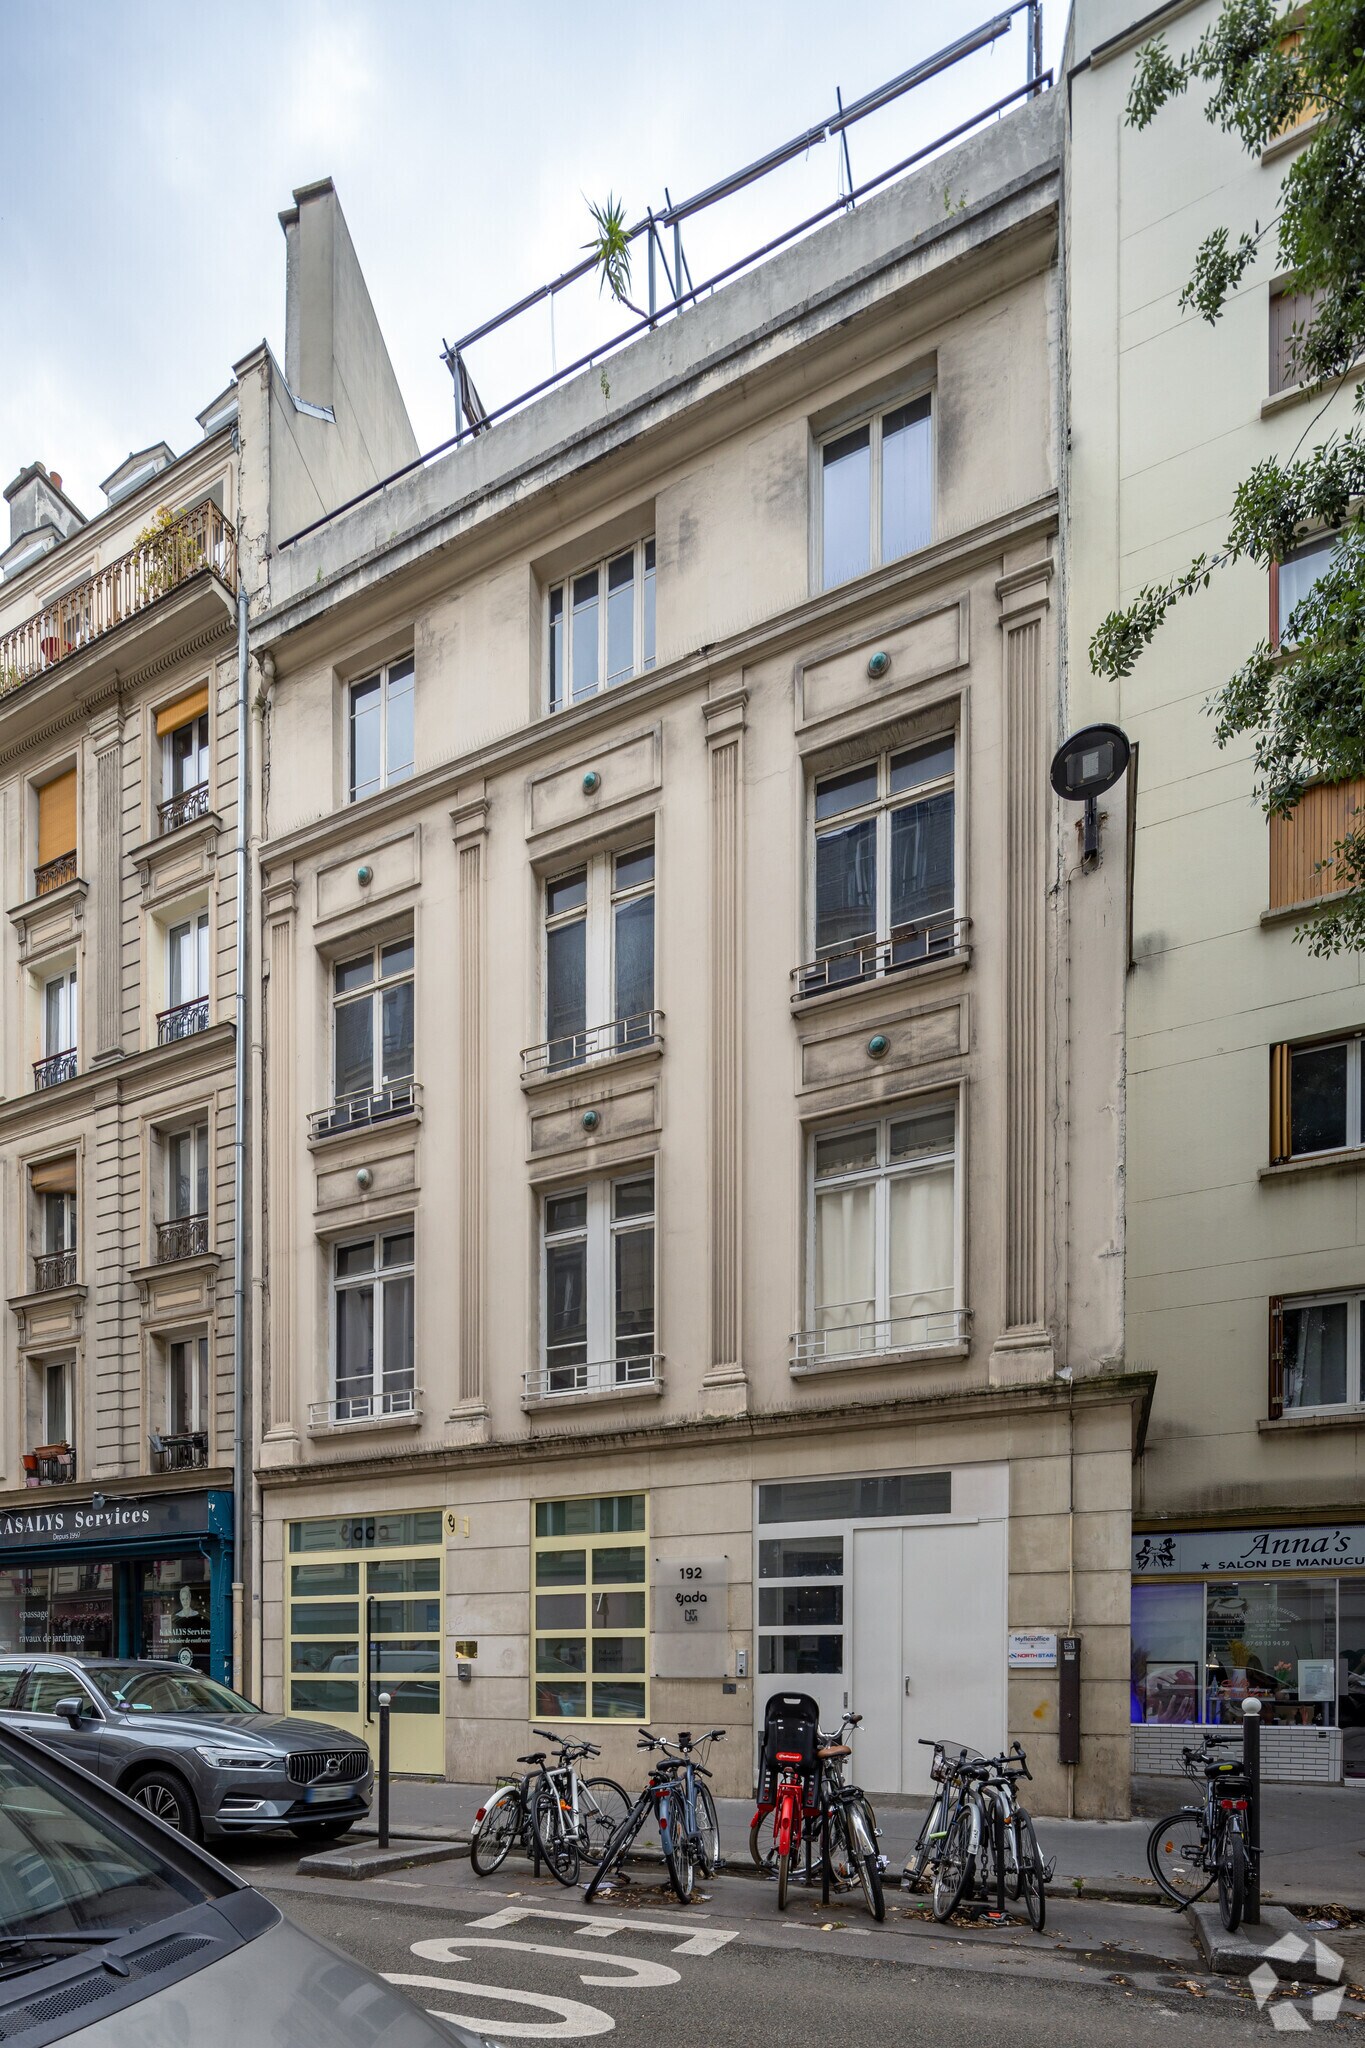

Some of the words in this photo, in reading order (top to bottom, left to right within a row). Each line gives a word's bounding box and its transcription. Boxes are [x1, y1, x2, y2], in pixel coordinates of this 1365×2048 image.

[75, 1507, 150, 1528] Services
[52, 1533, 69, 1541] Depuis
[1240, 1530, 1351, 1558] Anna's
[1218, 1560, 1267, 1570] SALON
[1272, 1559, 1291, 1568] DE
[1296, 1556, 1365, 1567] MANUCU
[680, 1567, 702, 1579] 192
[15, 1608, 48, 1620] epassage
[42, 1633, 51, 1642] de
[52, 1633, 85, 1645] jardinage
